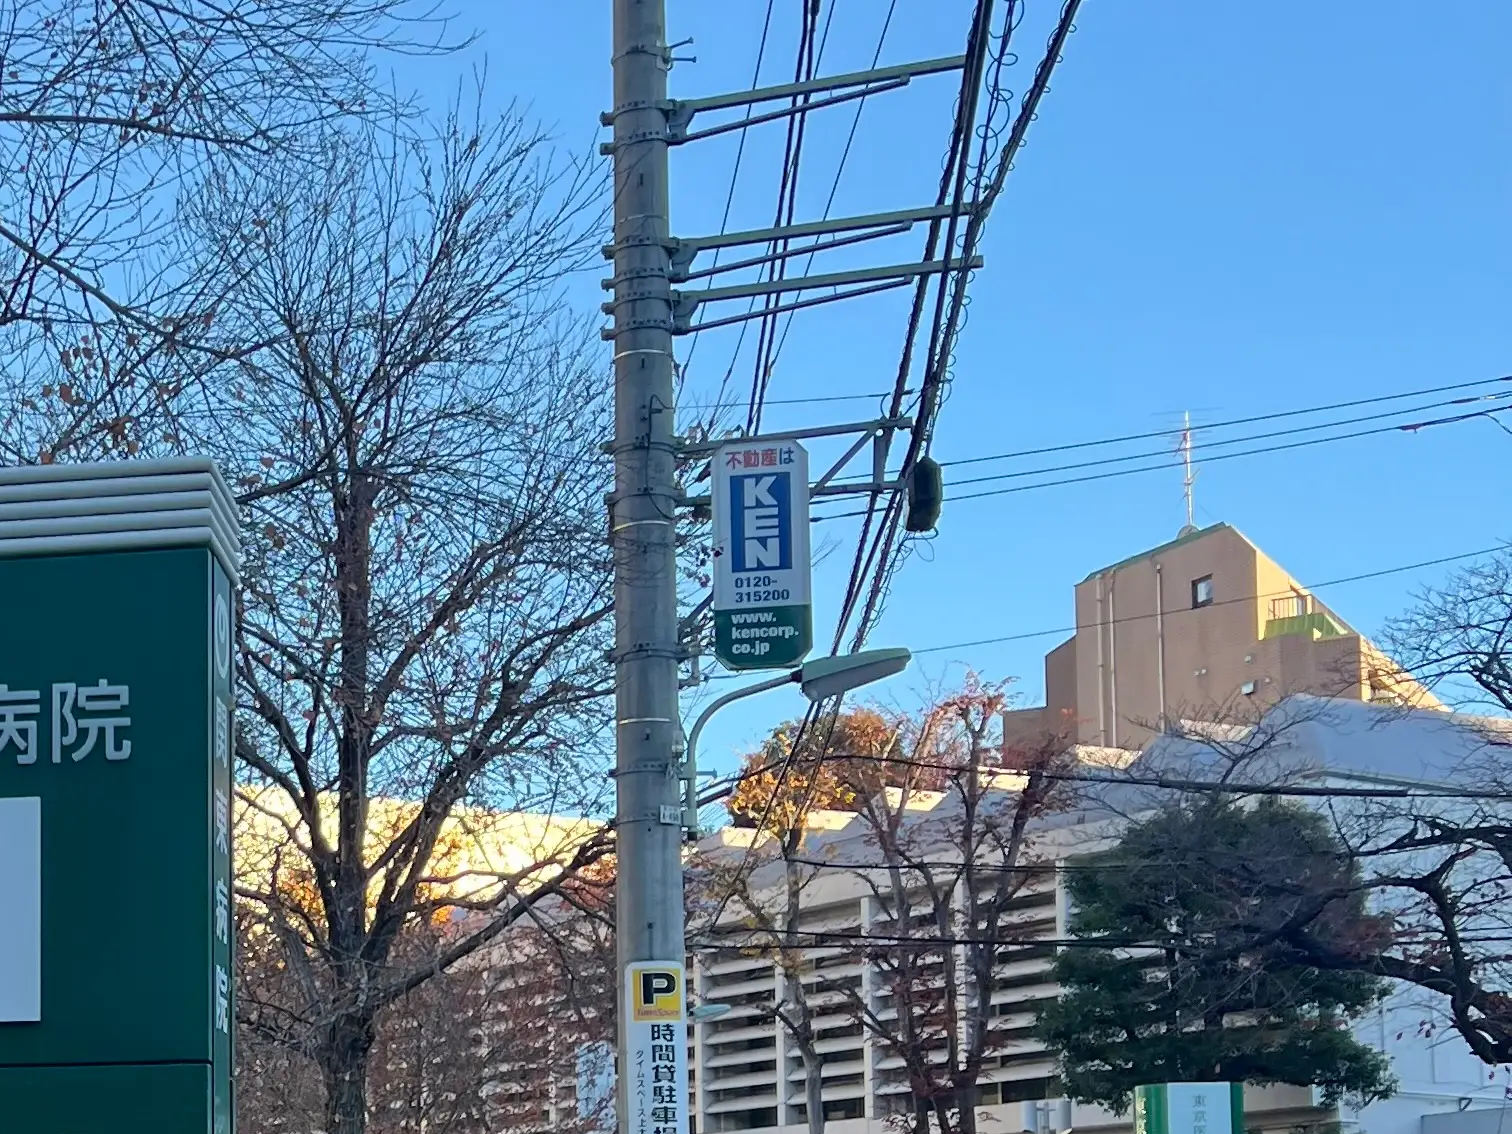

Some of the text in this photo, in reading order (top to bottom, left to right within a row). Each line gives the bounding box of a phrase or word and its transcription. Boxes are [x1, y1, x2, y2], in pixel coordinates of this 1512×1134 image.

[725, 447, 795, 470] 不動産は
[743, 475, 781, 570] KEN
[734, 576, 778, 589] 0120-
[735, 589, 790, 604] 315200
[731, 612, 777, 625] www.
[731, 625, 799, 640] kencorp.
[731, 641, 770, 656] co.jp
[641, 971, 676, 1006] P
